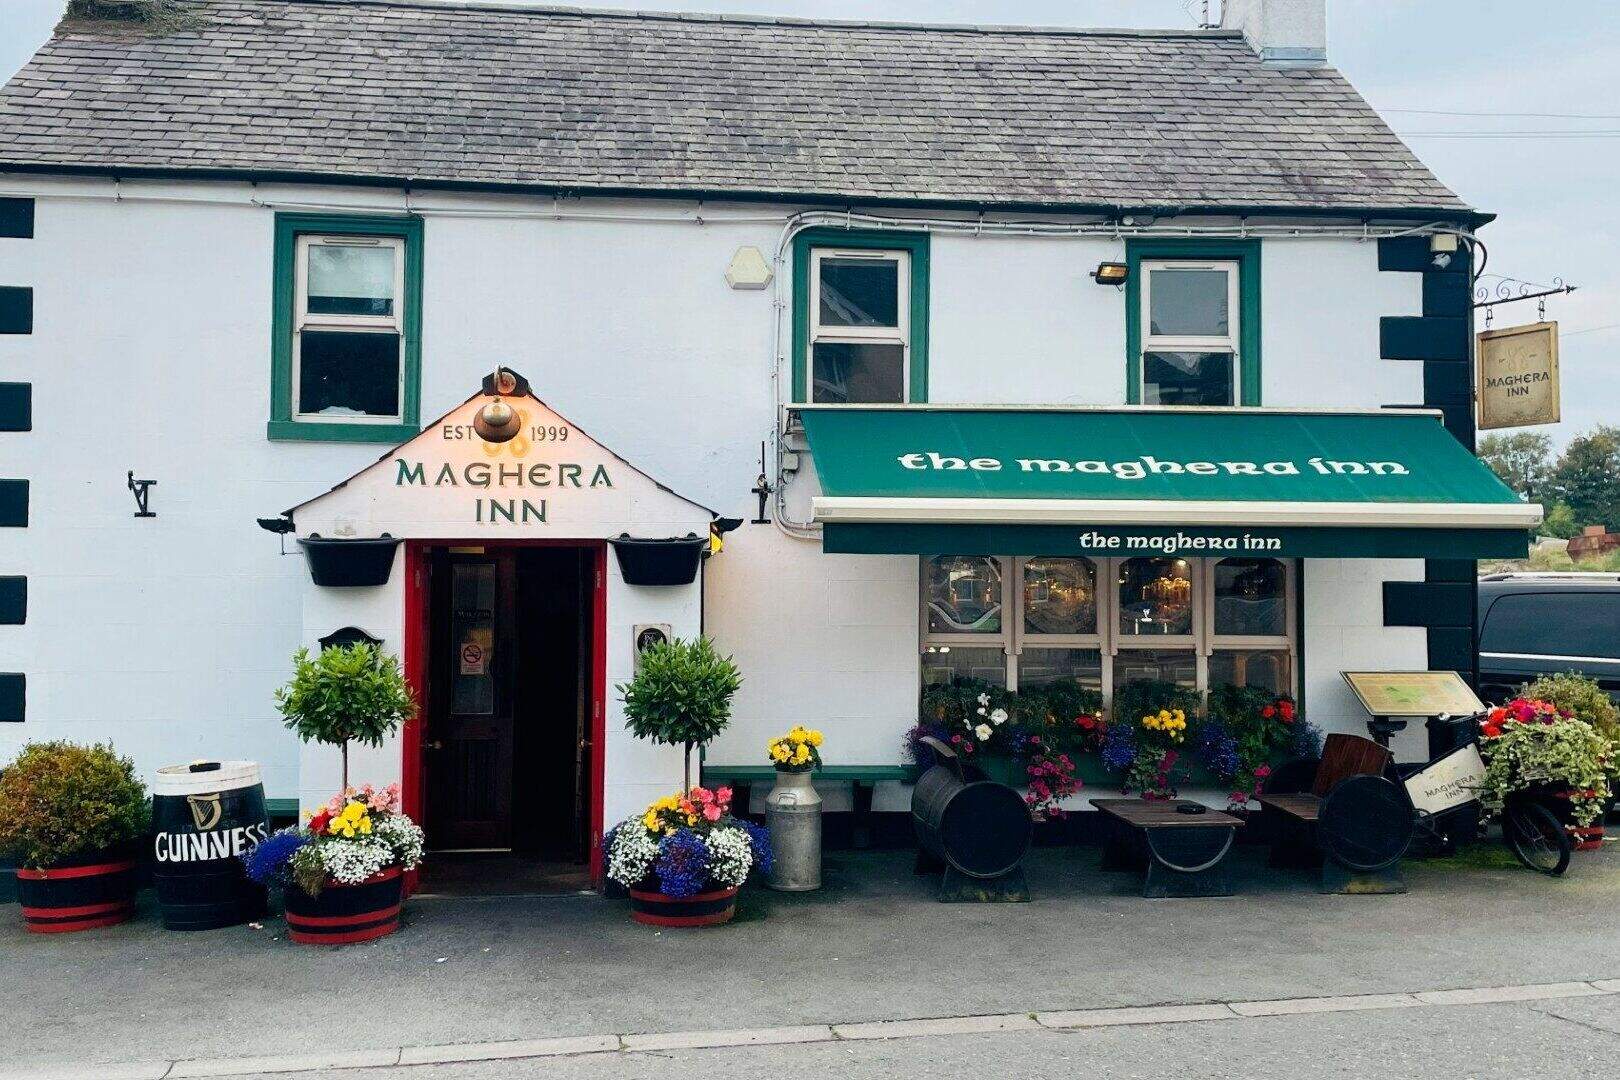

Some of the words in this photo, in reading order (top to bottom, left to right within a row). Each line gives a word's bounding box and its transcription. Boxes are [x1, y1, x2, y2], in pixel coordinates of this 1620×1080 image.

[1486, 371, 1550, 388] MAGHERA
[1507, 386, 1529, 397] INN
[443, 425, 475, 440] EST
[531, 426, 568, 441] 1999
[395, 458, 613, 488] MAGHERA
[897, 452, 1002, 471] the
[1015, 455, 1300, 479] maghera
[1307, 457, 1409, 475] inn
[475, 498, 548, 523] INN
[1079, 532, 1120, 548] the
[1126, 532, 1238, 553] maghera
[1242, 534, 1281, 549] inn
[1424, 774, 1476, 798] MAGHERA
[155, 822, 268, 863] GUINNESS
